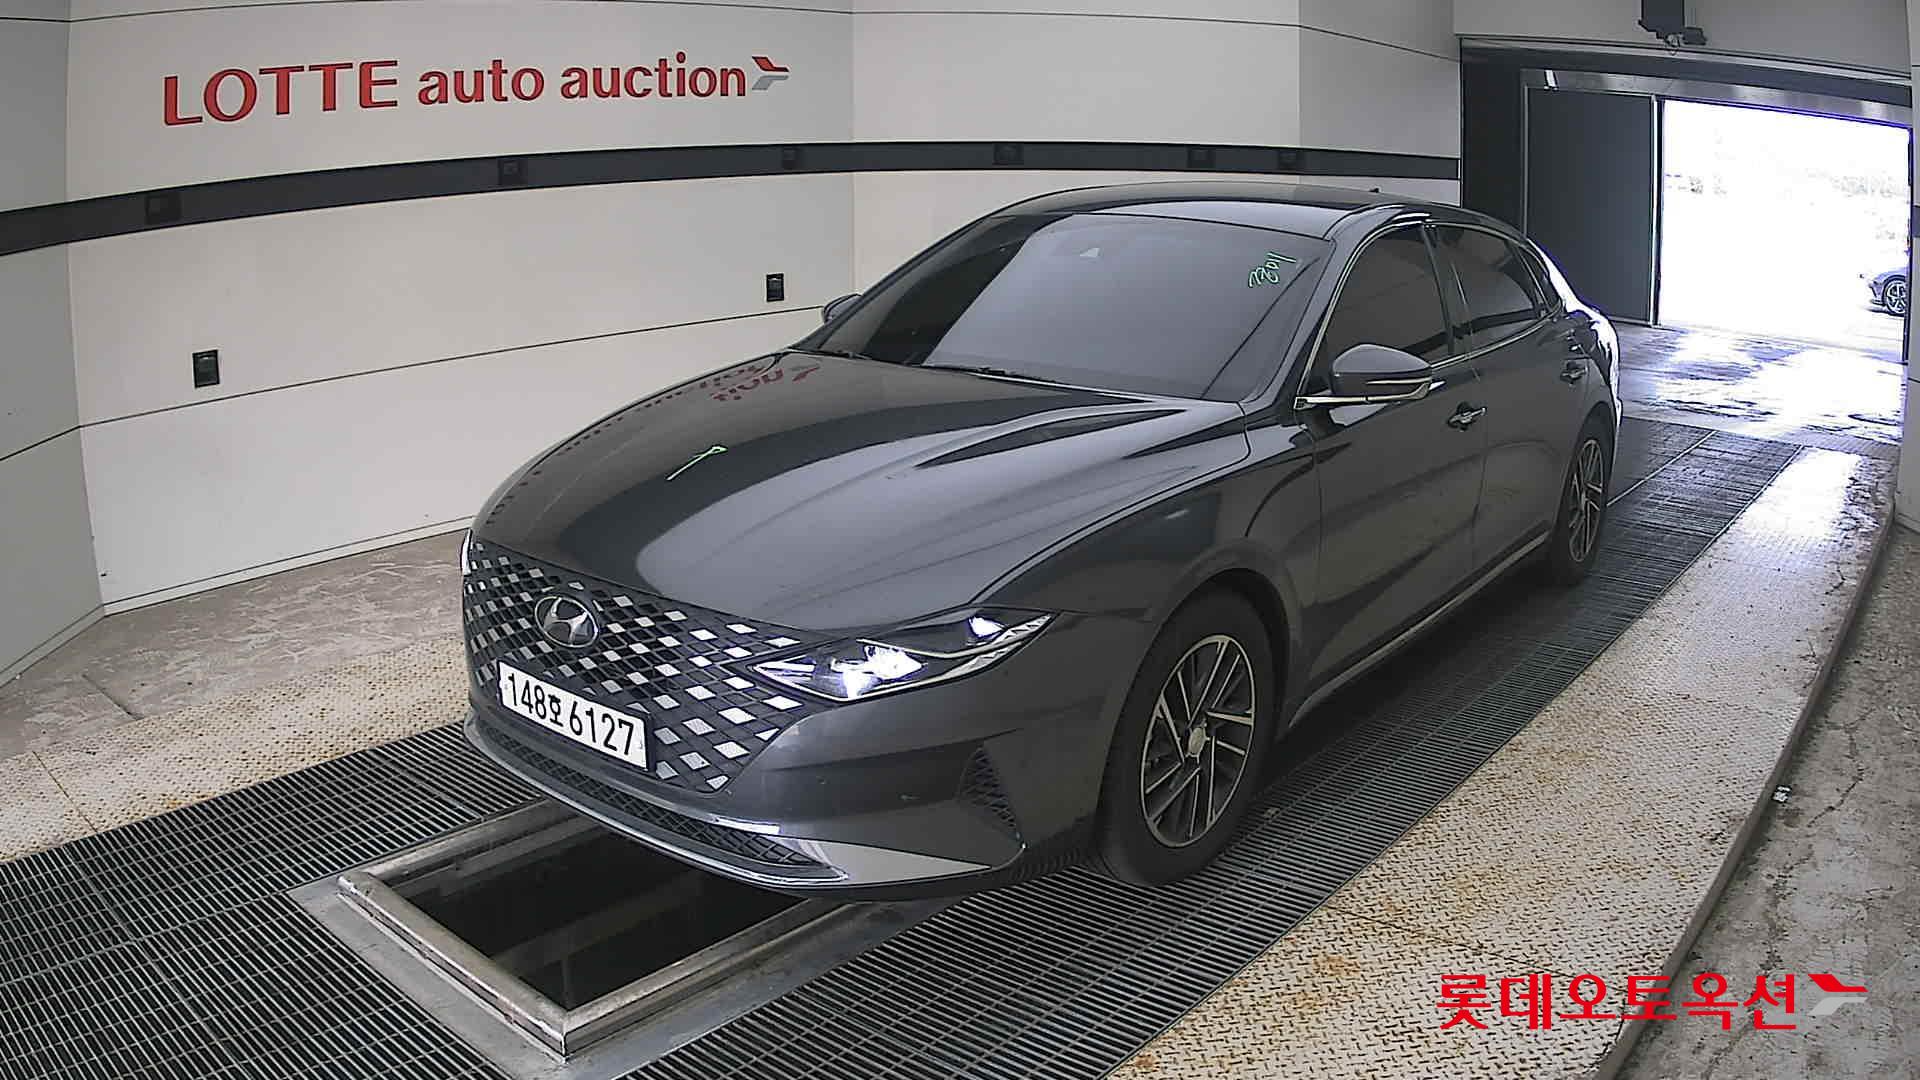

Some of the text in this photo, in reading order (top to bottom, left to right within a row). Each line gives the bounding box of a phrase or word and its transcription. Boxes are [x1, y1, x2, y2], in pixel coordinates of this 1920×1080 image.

[164, 52, 747, 126] LOTTE auto auction
